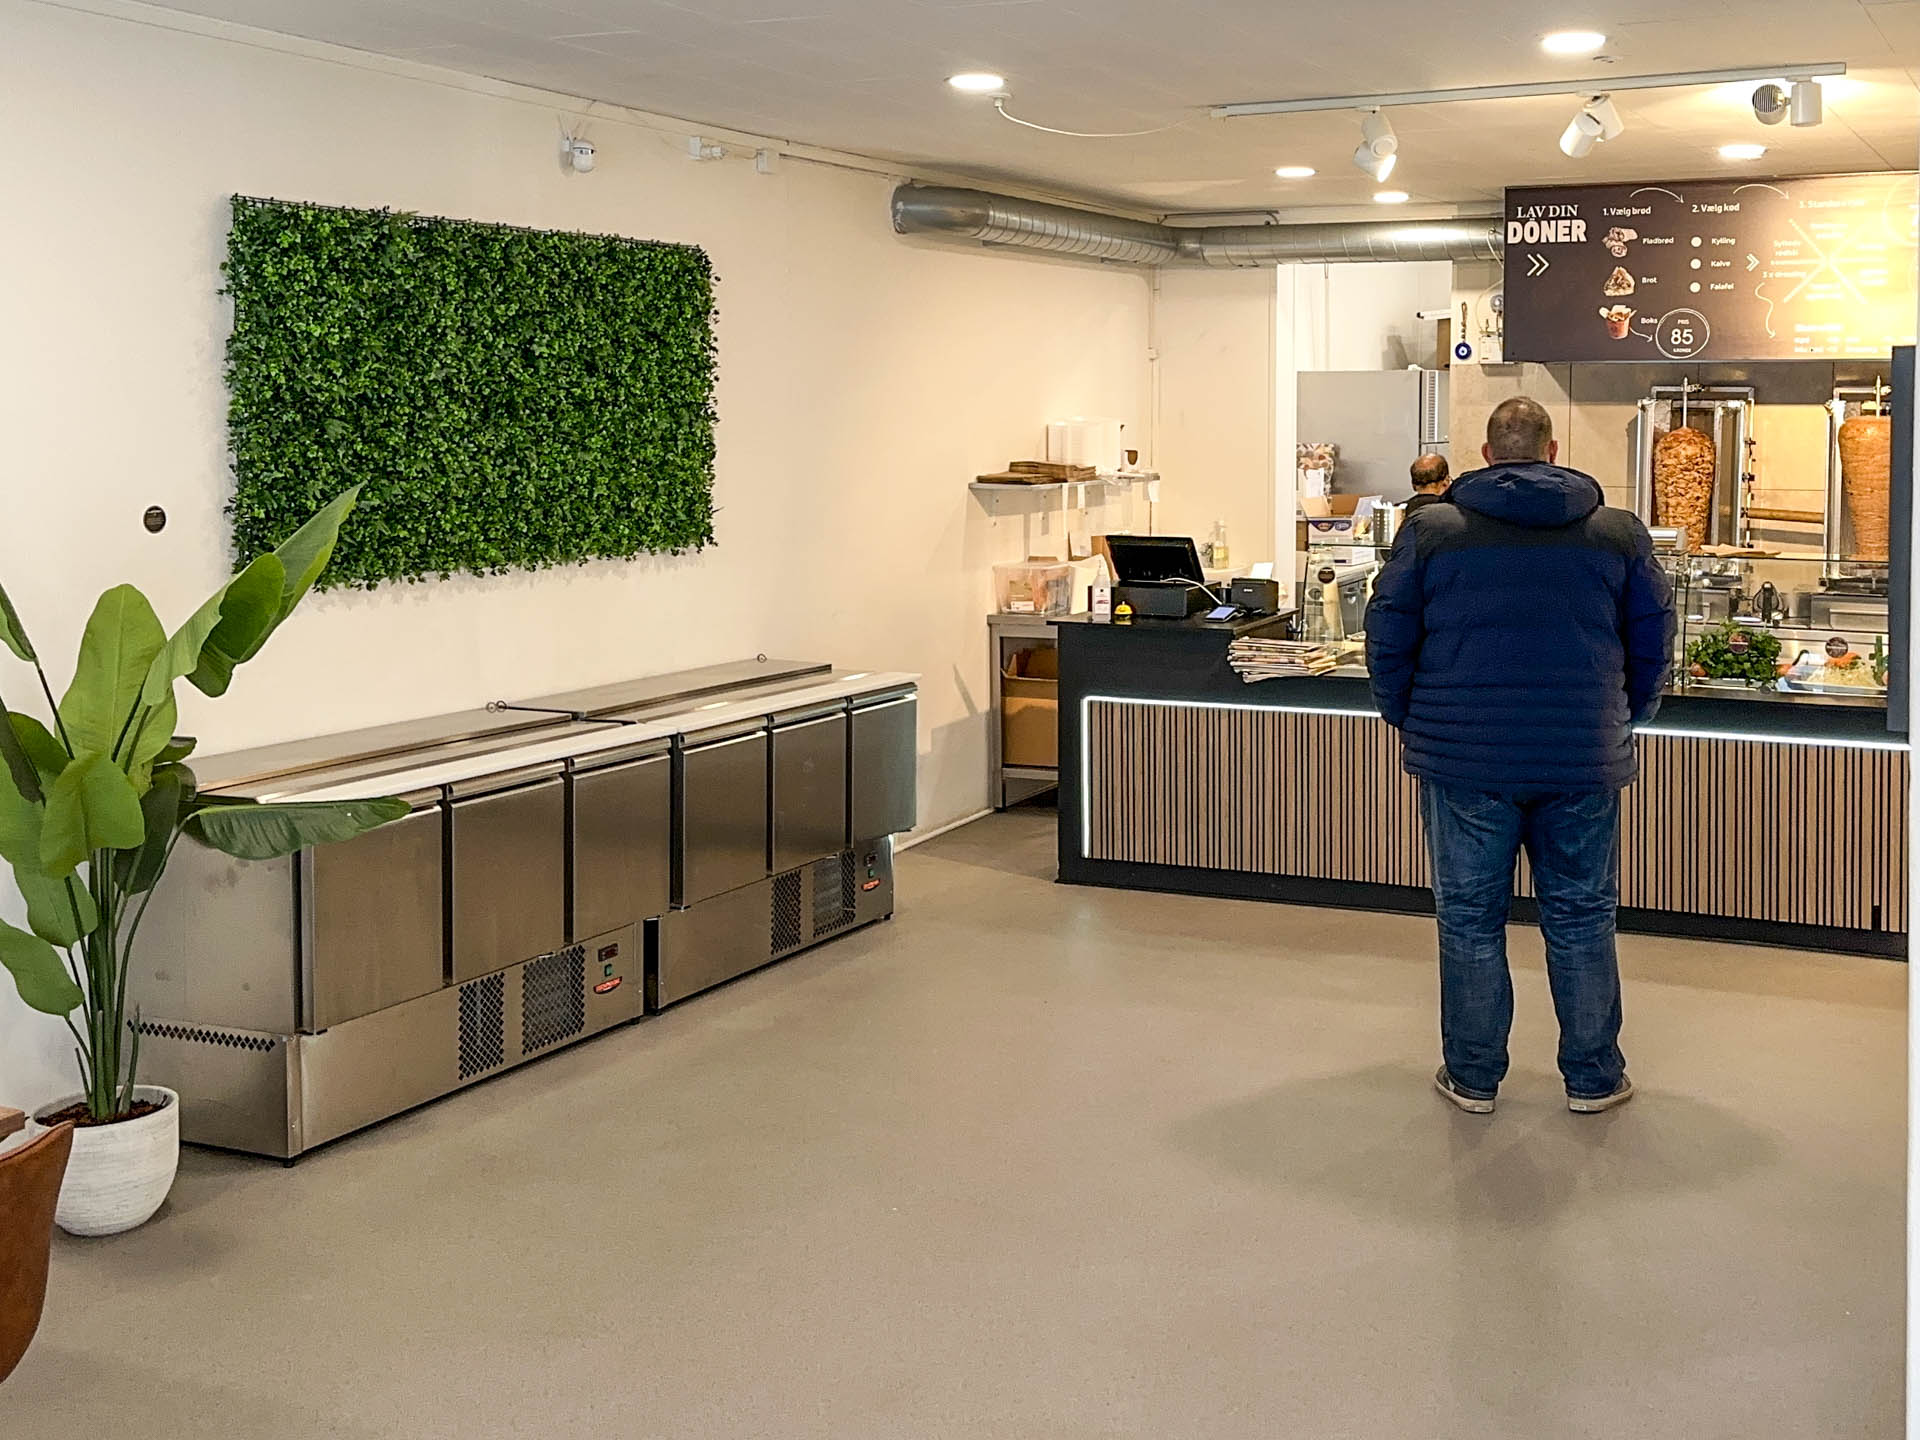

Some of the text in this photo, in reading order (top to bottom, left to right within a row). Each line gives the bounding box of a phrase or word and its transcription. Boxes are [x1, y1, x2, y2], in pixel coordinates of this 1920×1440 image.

[1517, 205, 1579, 218] LAV DIN
[1602, 206, 1651, 217] 1. Vælg brød
[1692, 204, 1700, 213] 2.
[1701, 204, 1722, 213] Vælg
[1507, 218, 1587, 244] DÖNER
[1643, 237, 1674, 245] Fladbrød
[1712, 237, 1736, 245] Kylling
[1671, 328, 1694, 345] 85
